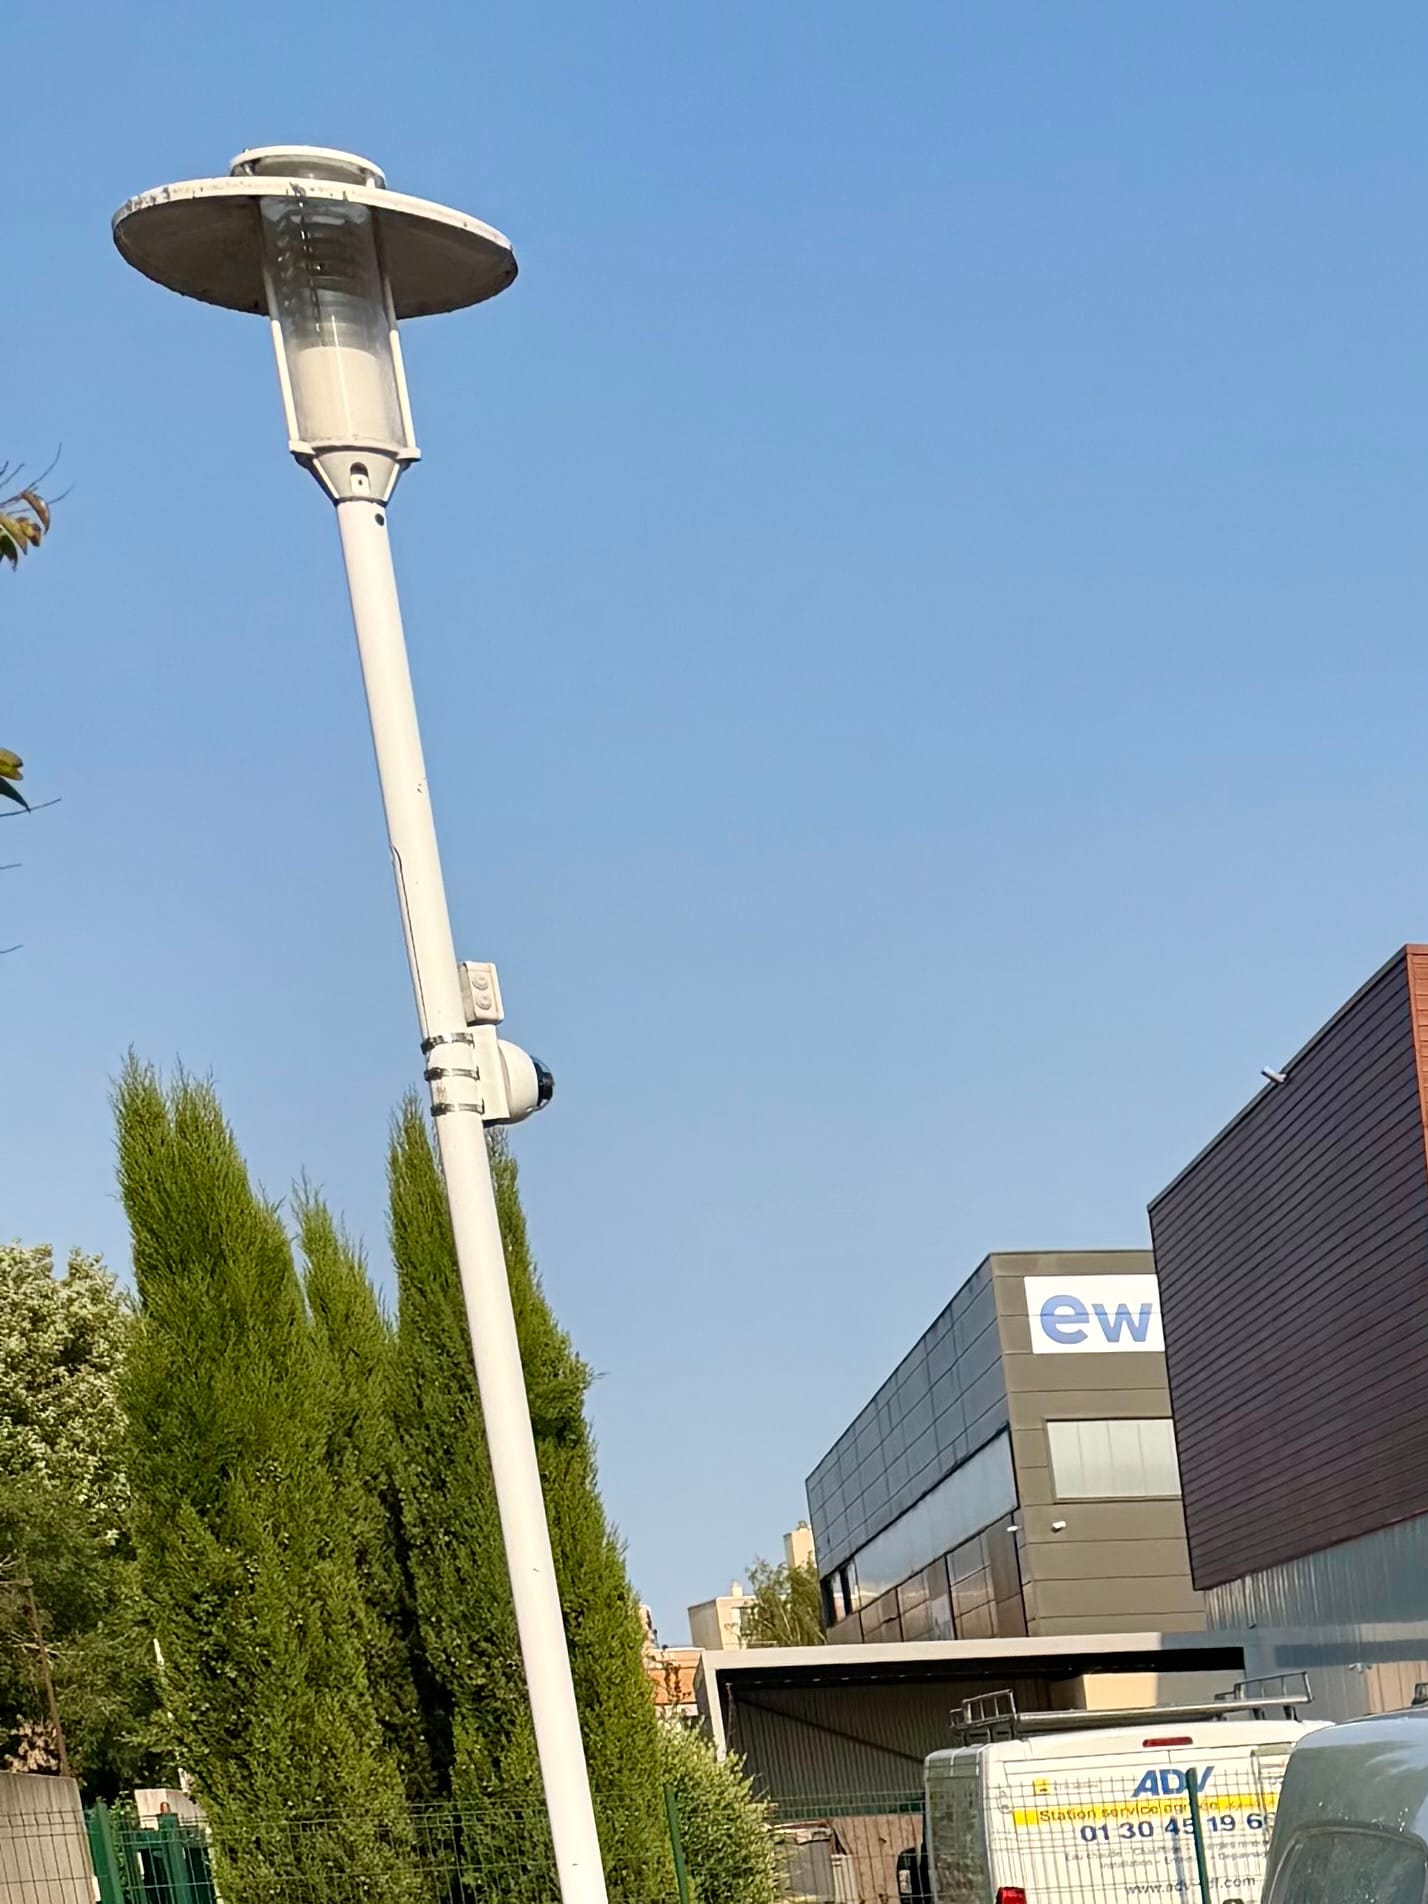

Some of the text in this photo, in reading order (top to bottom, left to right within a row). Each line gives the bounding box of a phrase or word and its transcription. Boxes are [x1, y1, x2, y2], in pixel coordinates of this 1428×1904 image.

[1040, 1294, 1153, 1344] ew
[1131, 1766, 1215, 1797] ADV
[1040, 1808, 1097, 1822] Station
[1080, 1825, 1110, 1842] 01
[1119, 1821, 1154, 1839] 30
[1164, 1818, 1195, 1835] 45
[1207, 1815, 1236, 1832] 19
